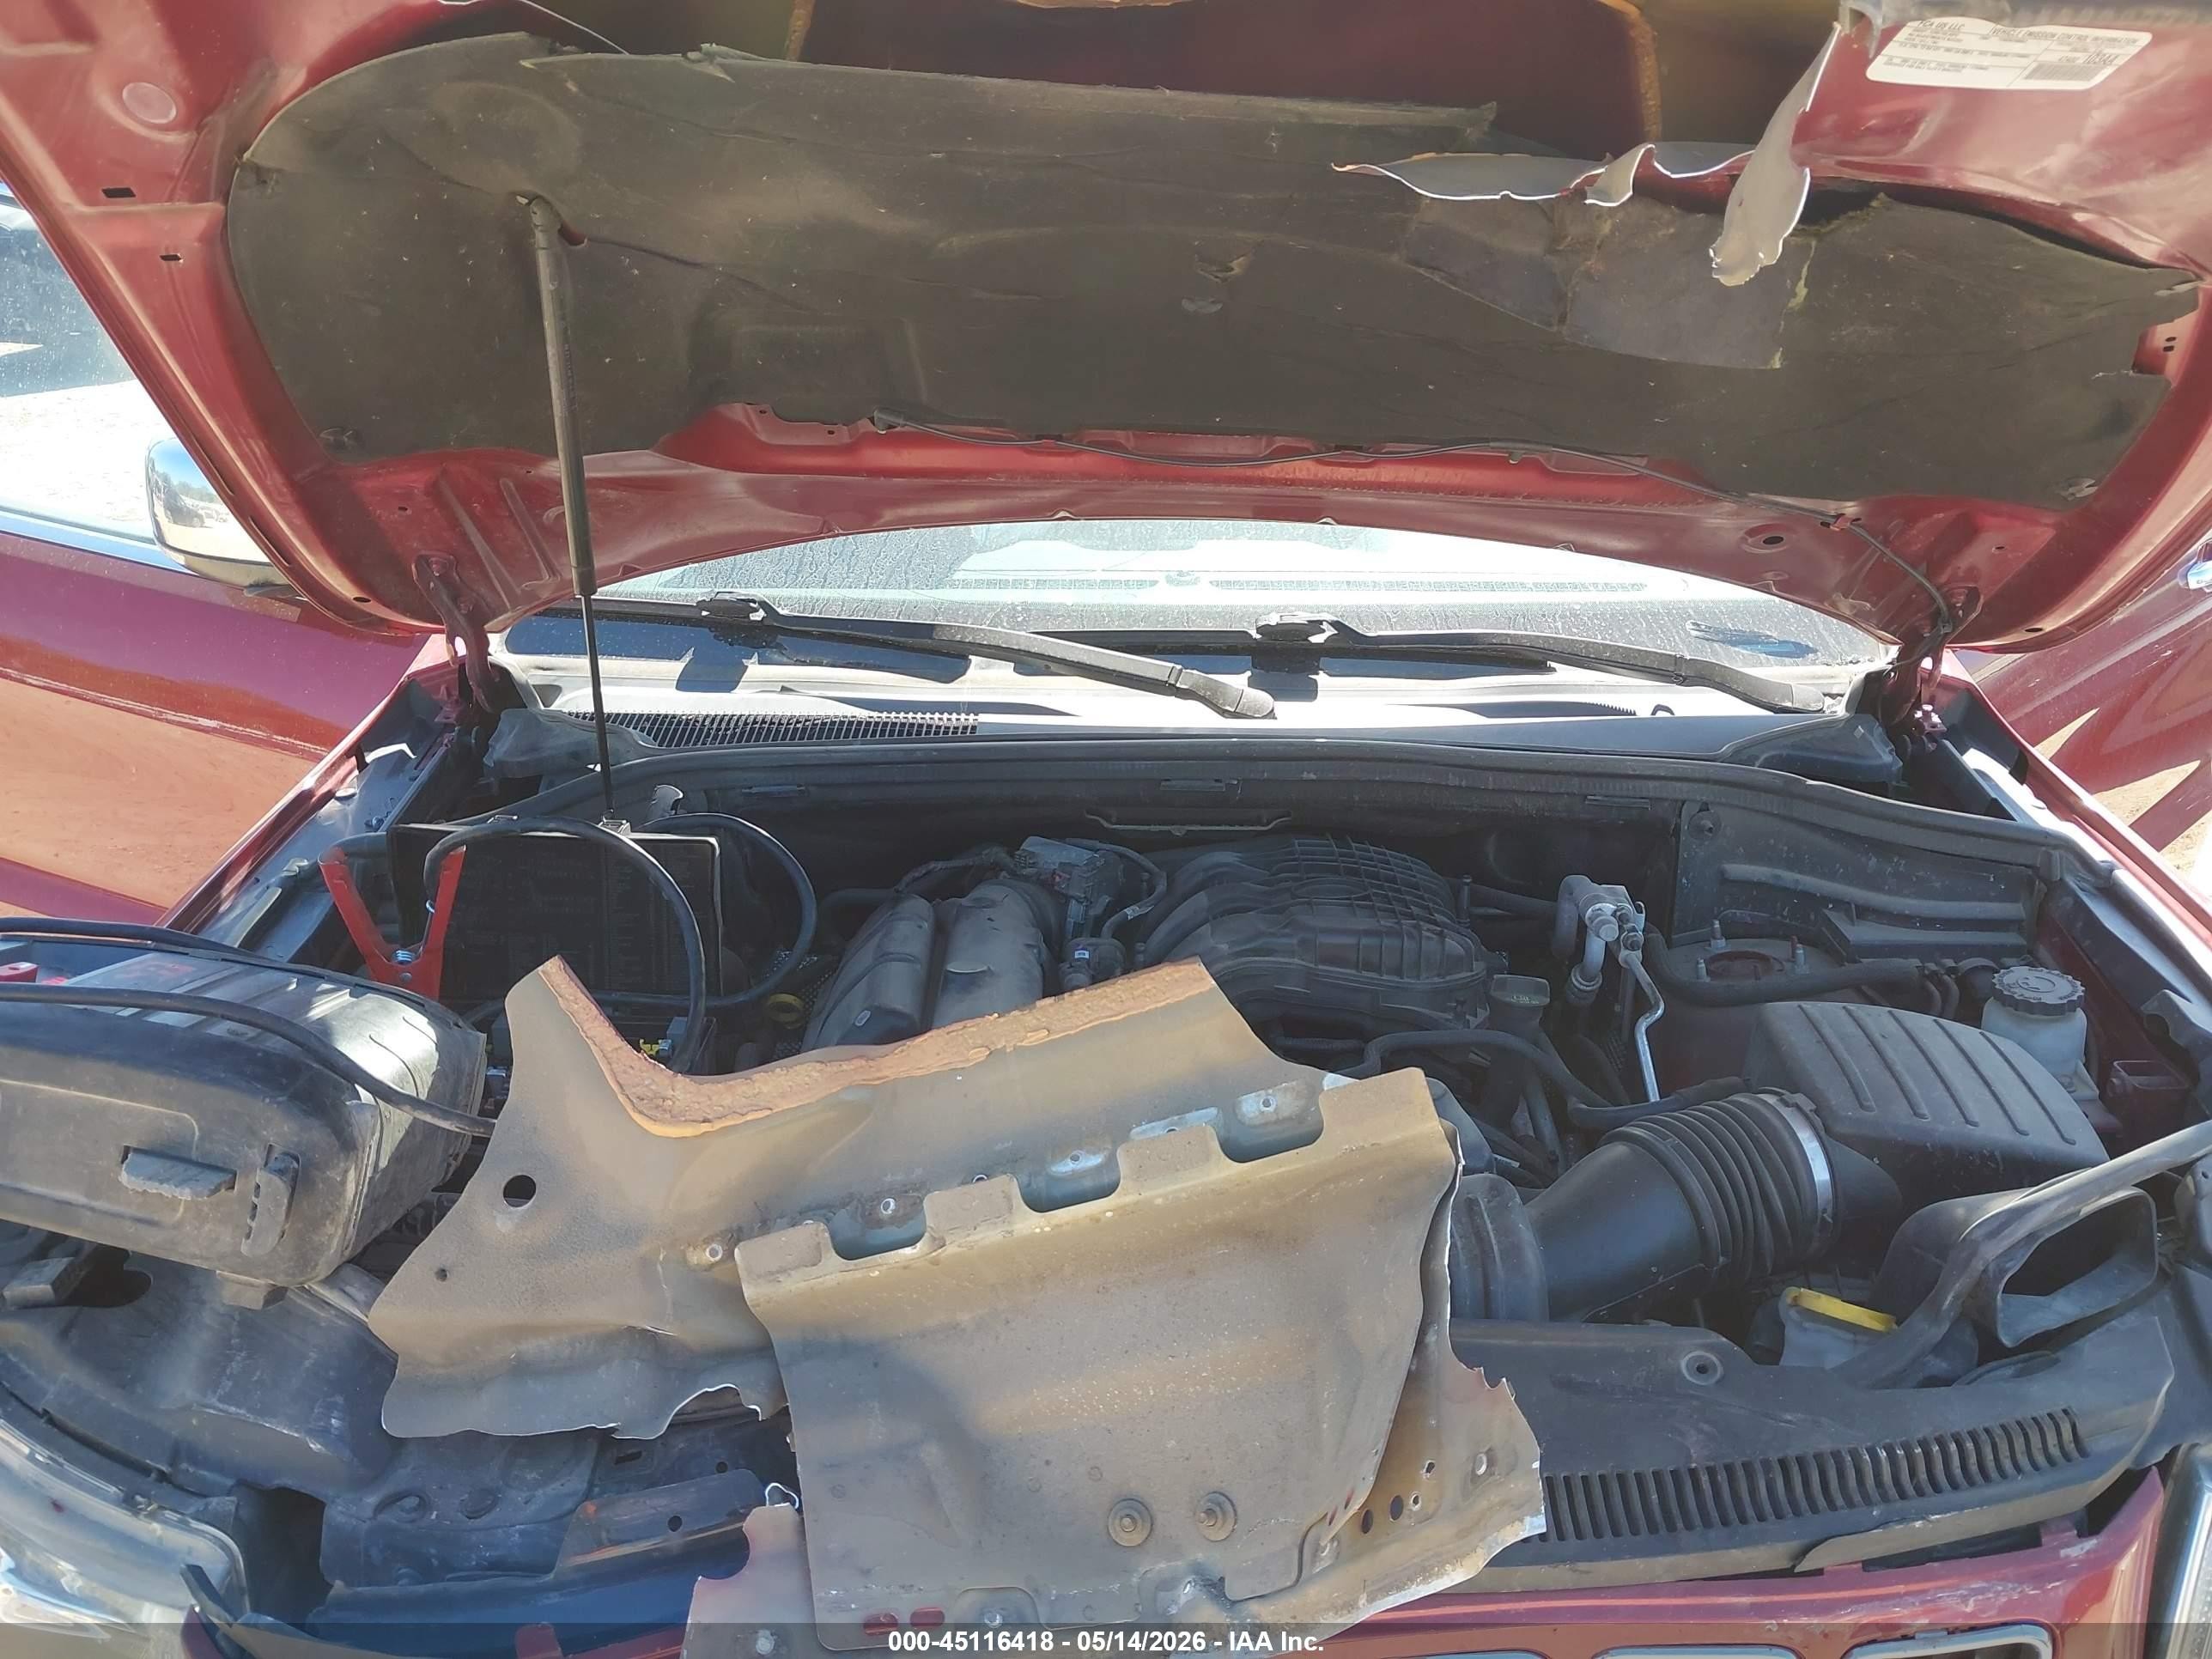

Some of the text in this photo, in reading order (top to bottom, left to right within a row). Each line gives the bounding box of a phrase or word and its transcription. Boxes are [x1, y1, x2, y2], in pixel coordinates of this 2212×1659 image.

[1936, 21, 1949, 29] US
[1948, 21, 1966, 31] LLC
[1991, 26, 2025, 37] VEHICLE
[2025, 29, 2057, 39] EMISSION
[2057, 32, 2089, 41] CONTROL
